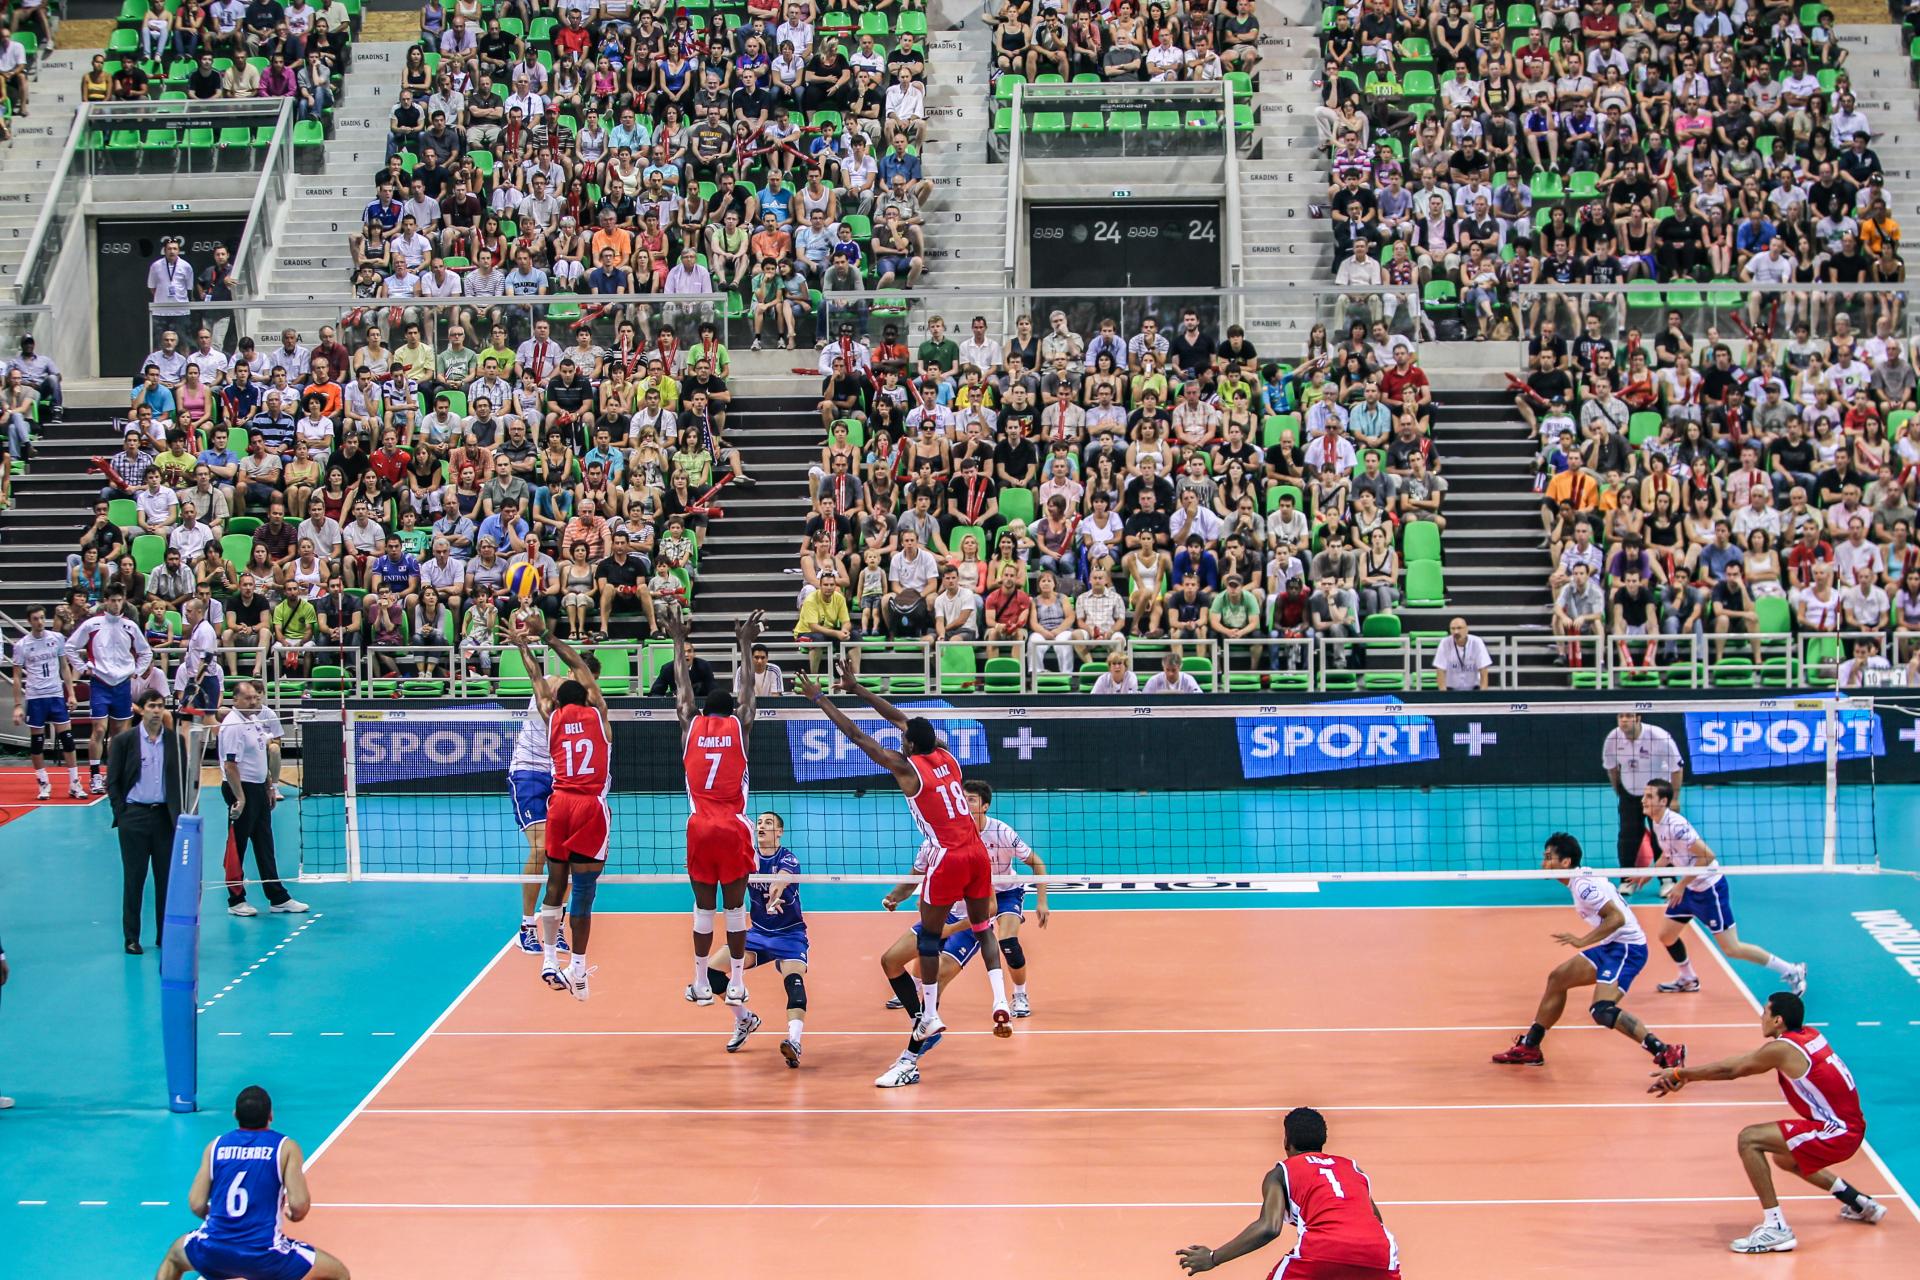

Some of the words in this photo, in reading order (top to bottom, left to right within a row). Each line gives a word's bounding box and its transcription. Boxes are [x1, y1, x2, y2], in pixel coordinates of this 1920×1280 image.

[374, 87, 381, 95] H
[956, 108, 963, 118] G
[1286, 104, 1293, 113] G
[363, 119, 370, 128] G
[342, 187, 348, 197] E
[954, 213, 961, 222] D
[1288, 208, 1294, 218] D
[331, 222, 338, 232] D
[1094, 221, 1121, 244] 24
[1188, 220, 1216, 243] 24
[12, 228, 19, 238] D
[954, 249, 961, 258] C
[321, 258, 327, 268] C
[953, 324, 961, 333] A
[1289, 319, 1296, 329] A
[564, 722, 585, 735] BELL
[697, 735, 732, 748] CAMEJO
[1250, 723, 1429, 758] SPORT
[1700, 719, 1875, 753] SPORT
[359, 730, 513, 764] SPOR
[561, 738, 595, 777] 12
[704, 752, 723, 790] 7
[935, 780, 970, 819] 18
[216, 1145, 274, 1161] GUTIERREZ
[1319, 1167, 1345, 1199] 1
[226, 1170, 249, 1218] 6
